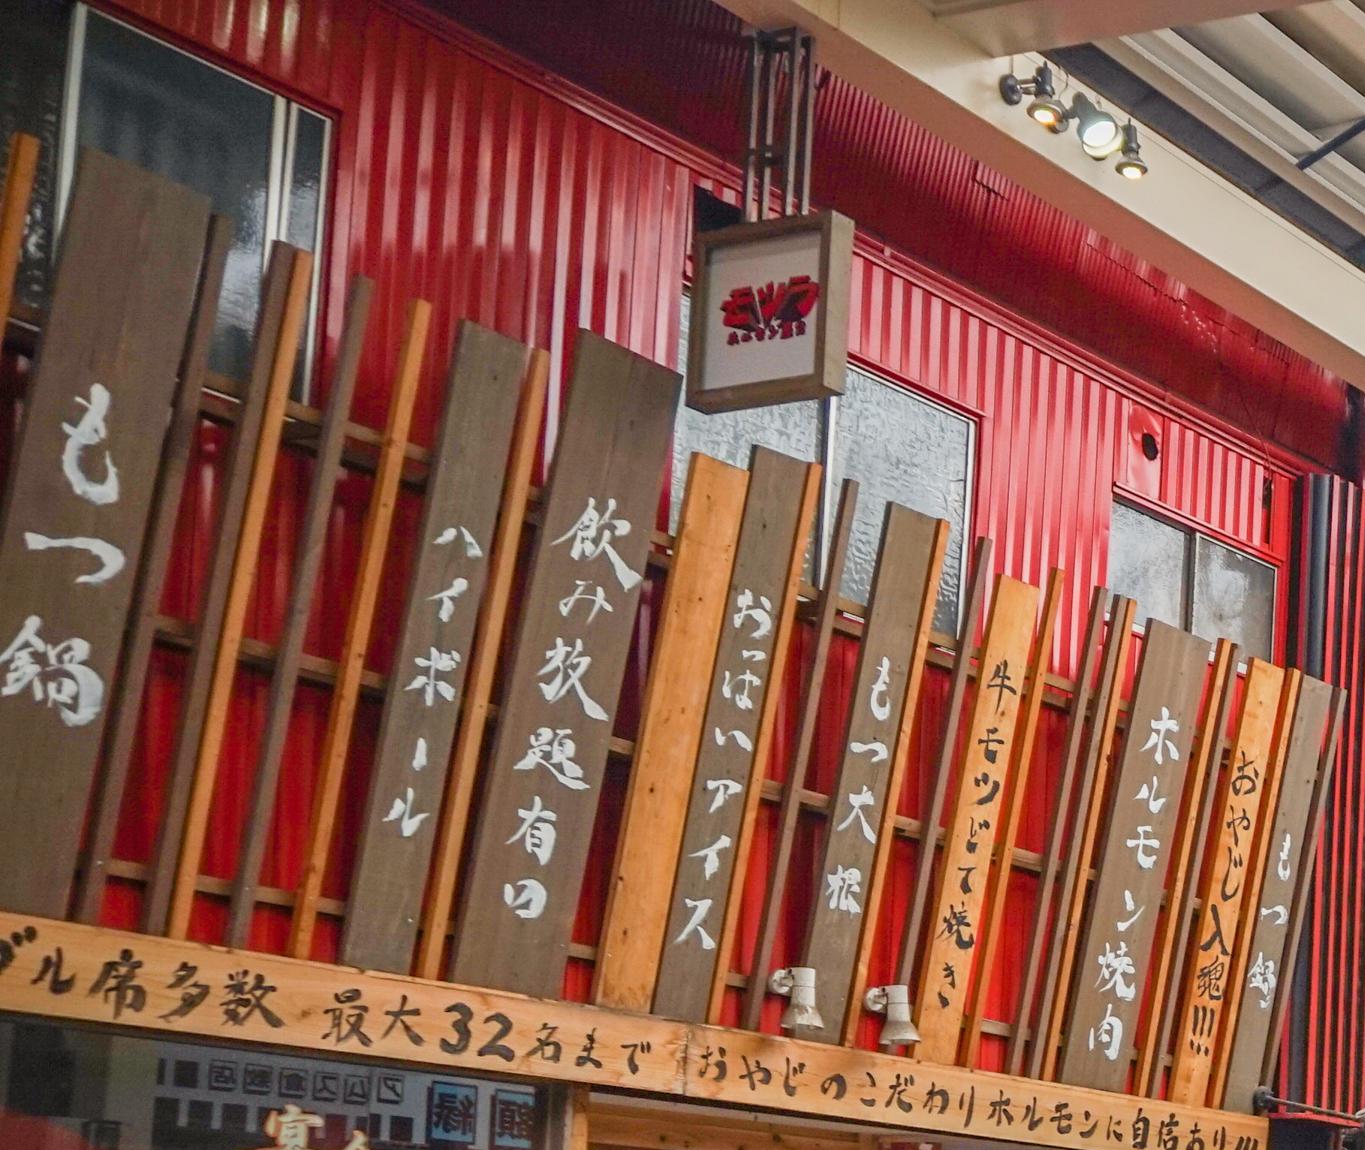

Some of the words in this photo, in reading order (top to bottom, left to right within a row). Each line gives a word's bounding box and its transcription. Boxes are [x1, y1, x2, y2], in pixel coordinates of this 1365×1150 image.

[0, 383, 125, 726] もつ鍋
[382, 526, 483, 836] ハイボール
[826, 656, 891, 913] もつ大根
[936, 660, 1017, 1008] 牛モツどて焼き
[1089, 706, 1180, 1061] ホルモン焼肉
[321, 988, 653, 1075] 最大32名まで
